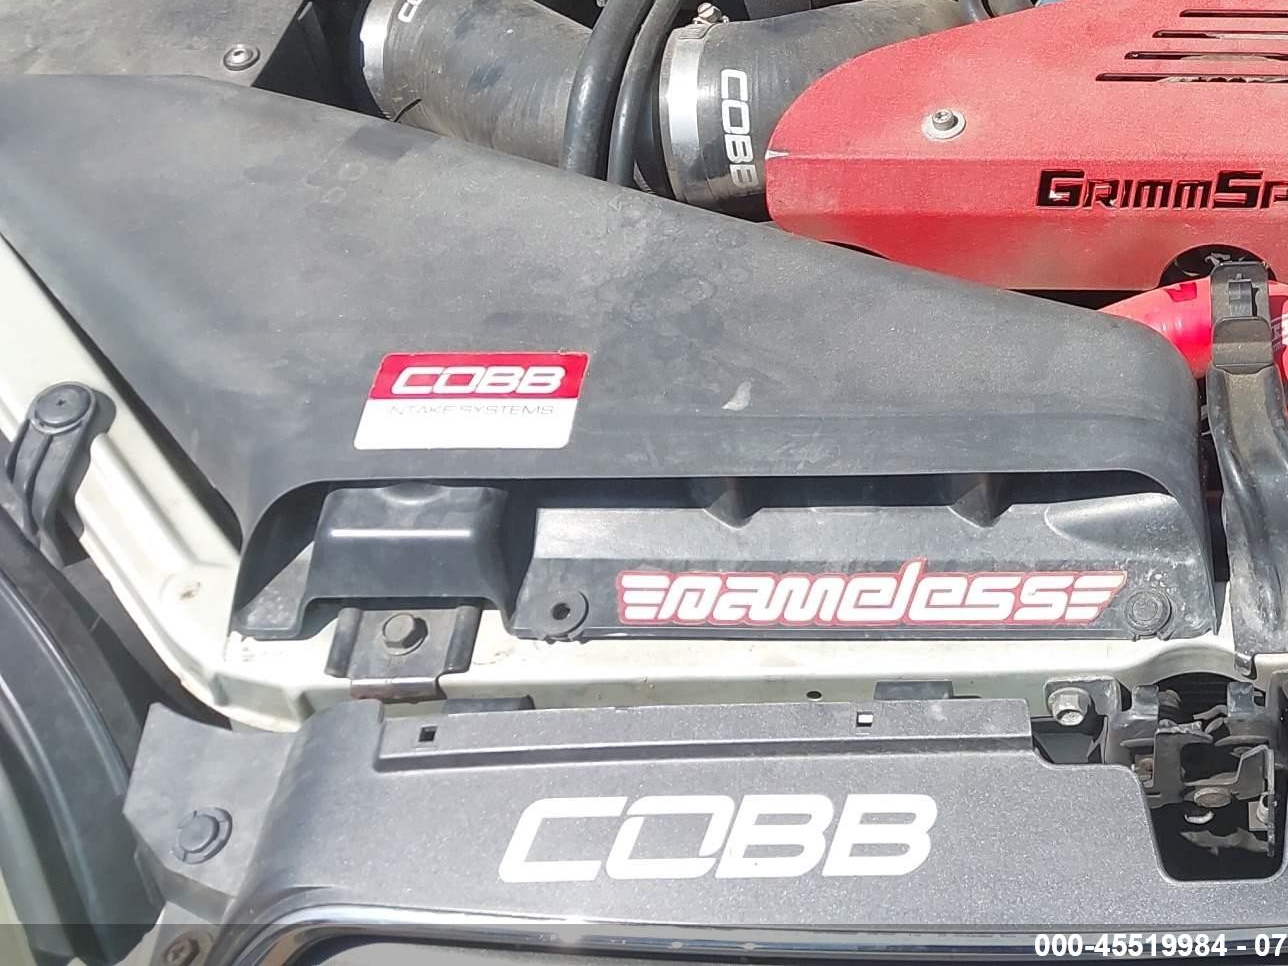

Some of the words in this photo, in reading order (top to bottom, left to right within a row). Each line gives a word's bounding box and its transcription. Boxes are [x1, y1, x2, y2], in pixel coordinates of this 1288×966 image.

[720, 68, 759, 187] COBB
[392, 366, 566, 394] COBB
[386, 404, 455, 416] NTAKE
[459, 405, 554, 416] SYSTEMS
[498, 793, 938, 883] COBB
